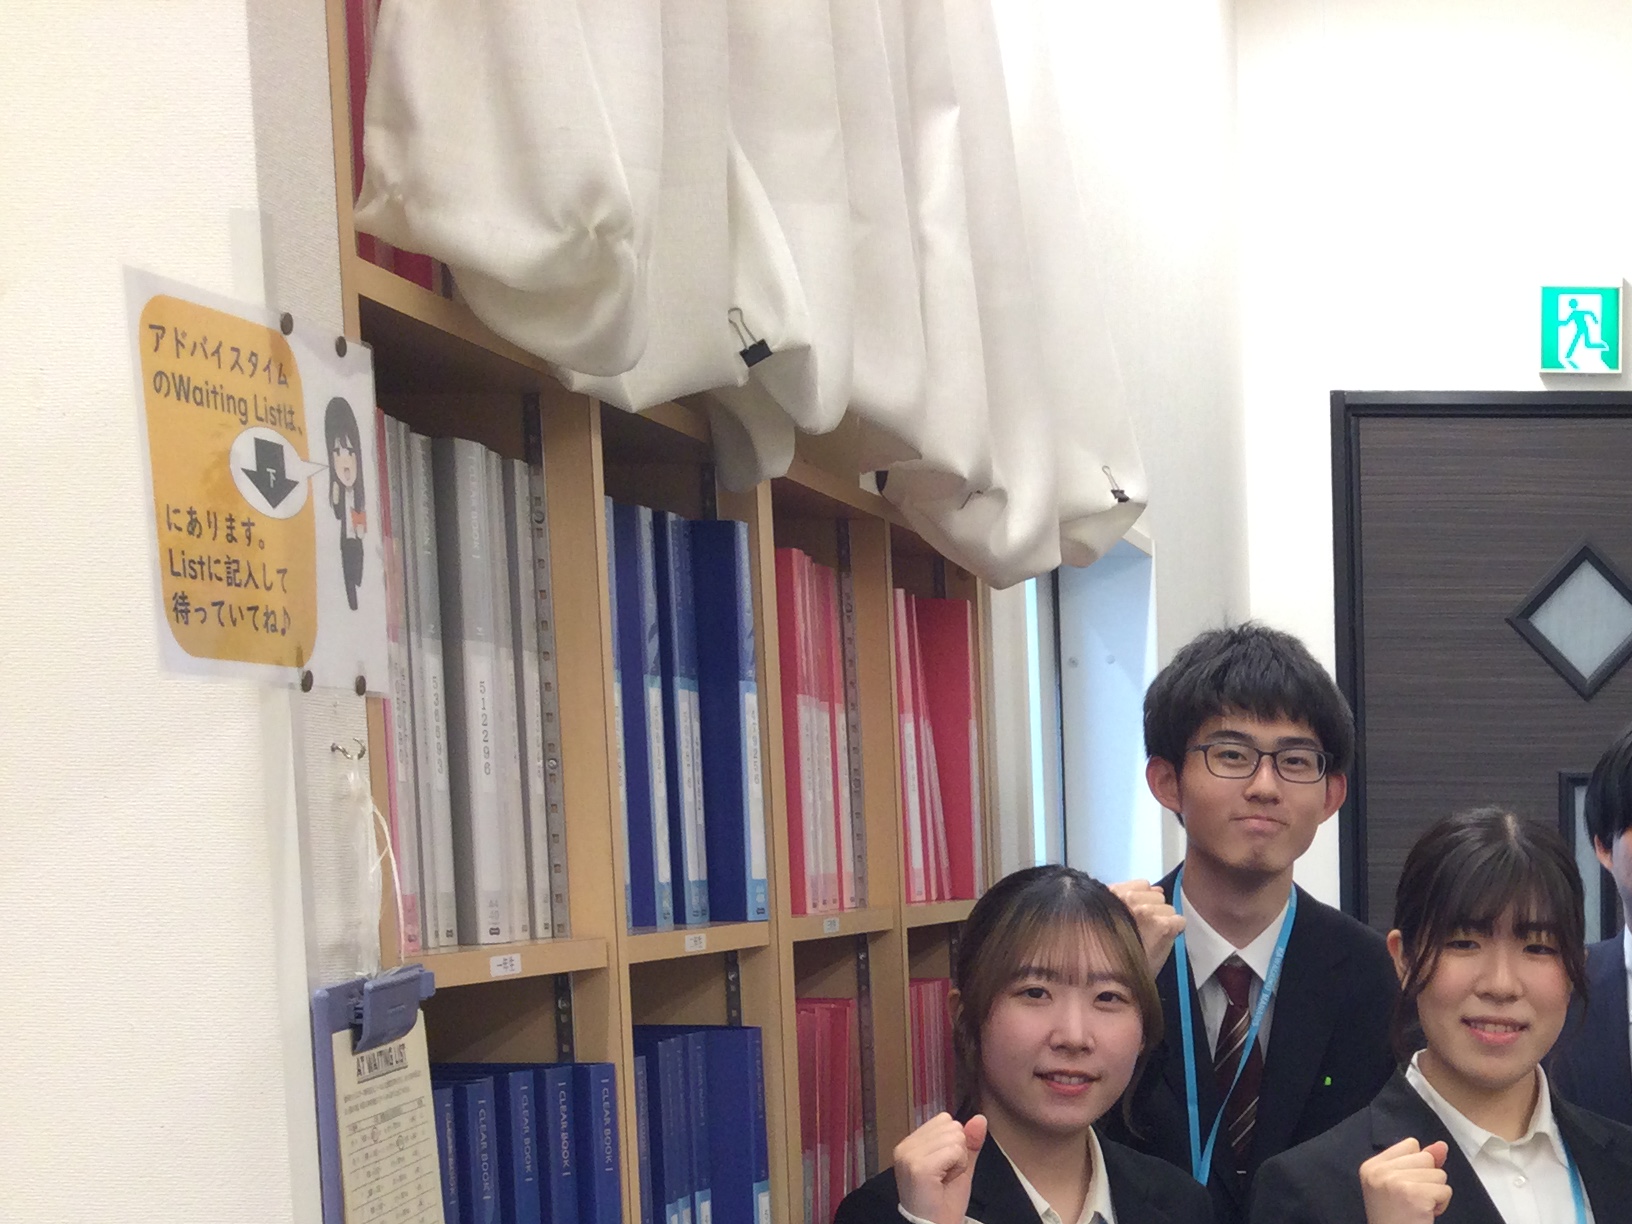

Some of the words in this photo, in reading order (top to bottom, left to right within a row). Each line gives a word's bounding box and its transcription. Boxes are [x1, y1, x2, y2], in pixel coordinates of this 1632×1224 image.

[148, 323, 289, 388] アドバイスタイム
[153, 369, 247, 426] のWaiting
[266, 467, 277, 488] 下
[166, 503, 266, 550] にあります。
[169, 547, 288, 593] Listに記入して
[521, 1095, 531, 1134] CLEAR
[558, 1091, 569, 1129] CLEAR
[601, 1088, 612, 1126] CLEAR
[478, 1109, 488, 1152] CLEAR
[603, 1129, 614, 1163] BOOK
[523, 1138, 533, 1173] BOOK
[560, 1132, 571, 1168] BOOK
[481, 1154, 491, 1191] BOOK
